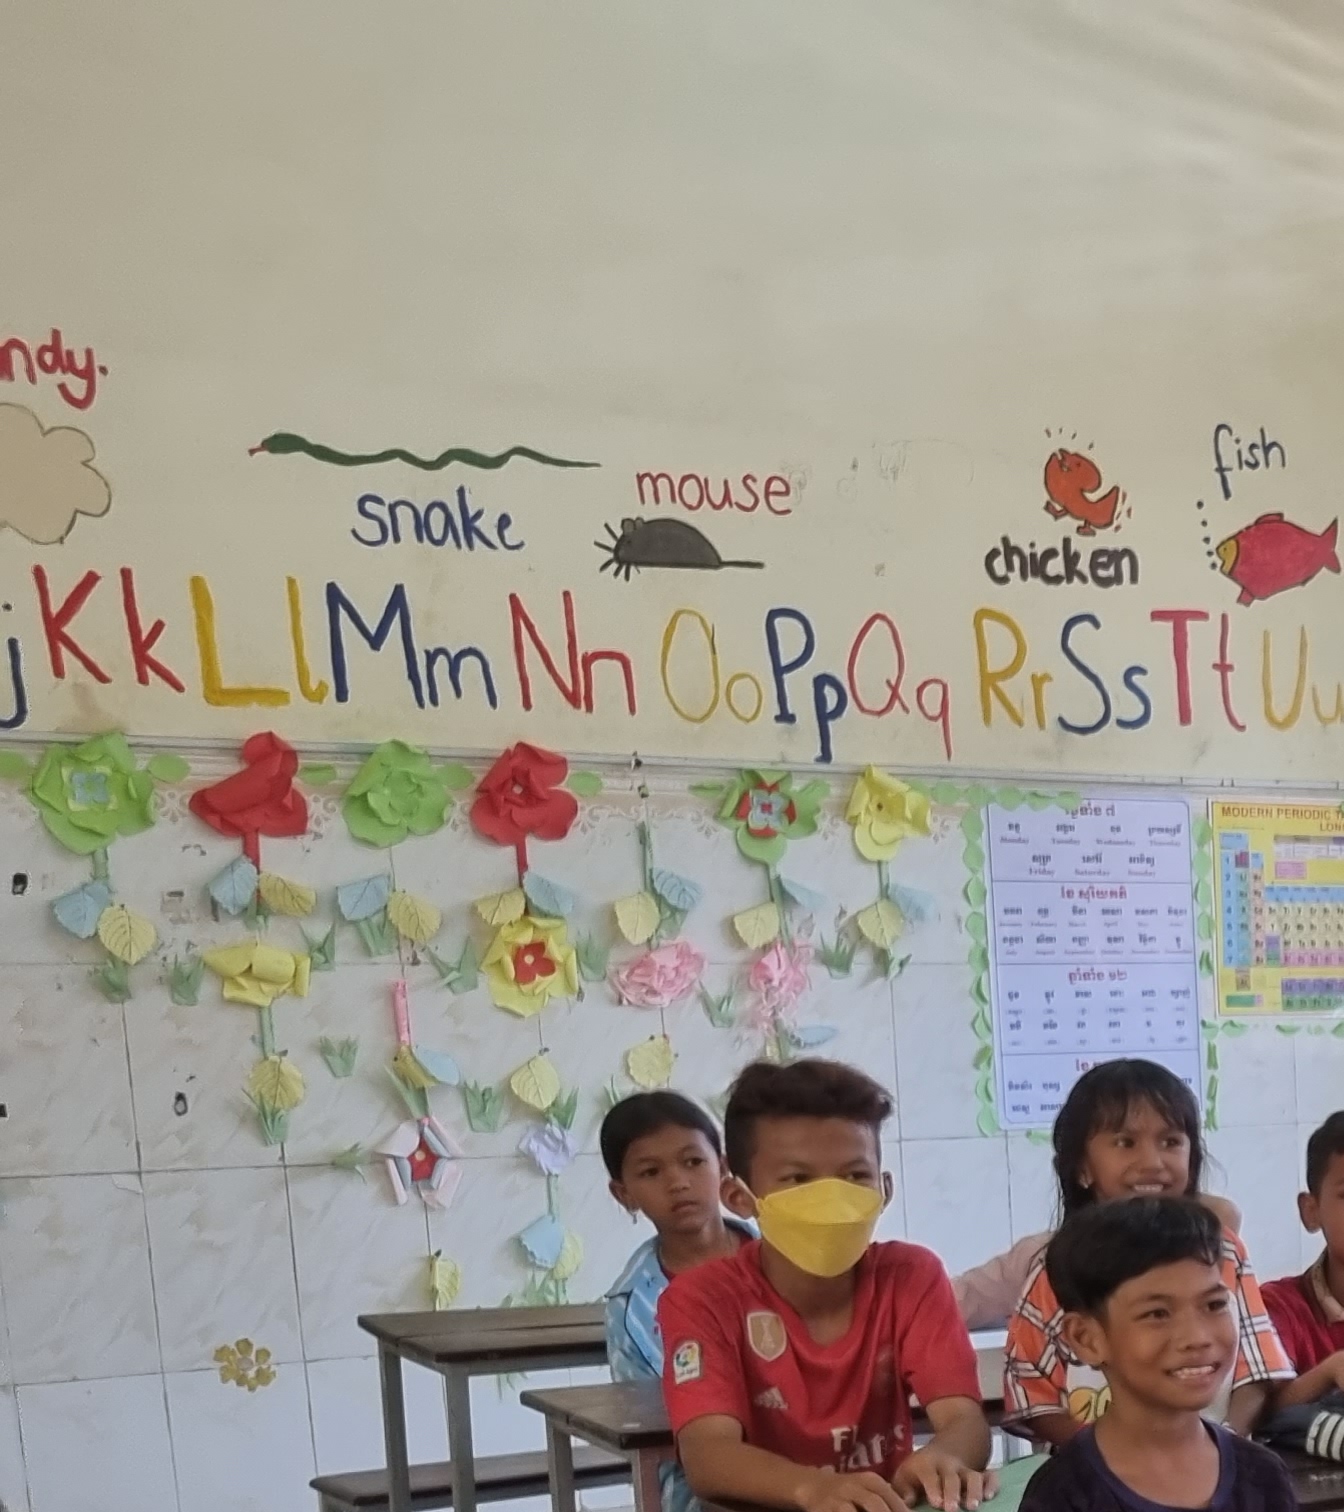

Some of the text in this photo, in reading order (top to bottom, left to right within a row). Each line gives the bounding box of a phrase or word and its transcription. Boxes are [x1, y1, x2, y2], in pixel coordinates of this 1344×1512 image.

[1212, 424, 1288, 500] fish
[350, 484, 526, 552] snake
[635, 468, 794, 516] mouse
[983, 535, 1141, 589] chicken
[1221, 806, 1274, 819] MODERN
[1276, 808, 1330, 822] PERIODIC
